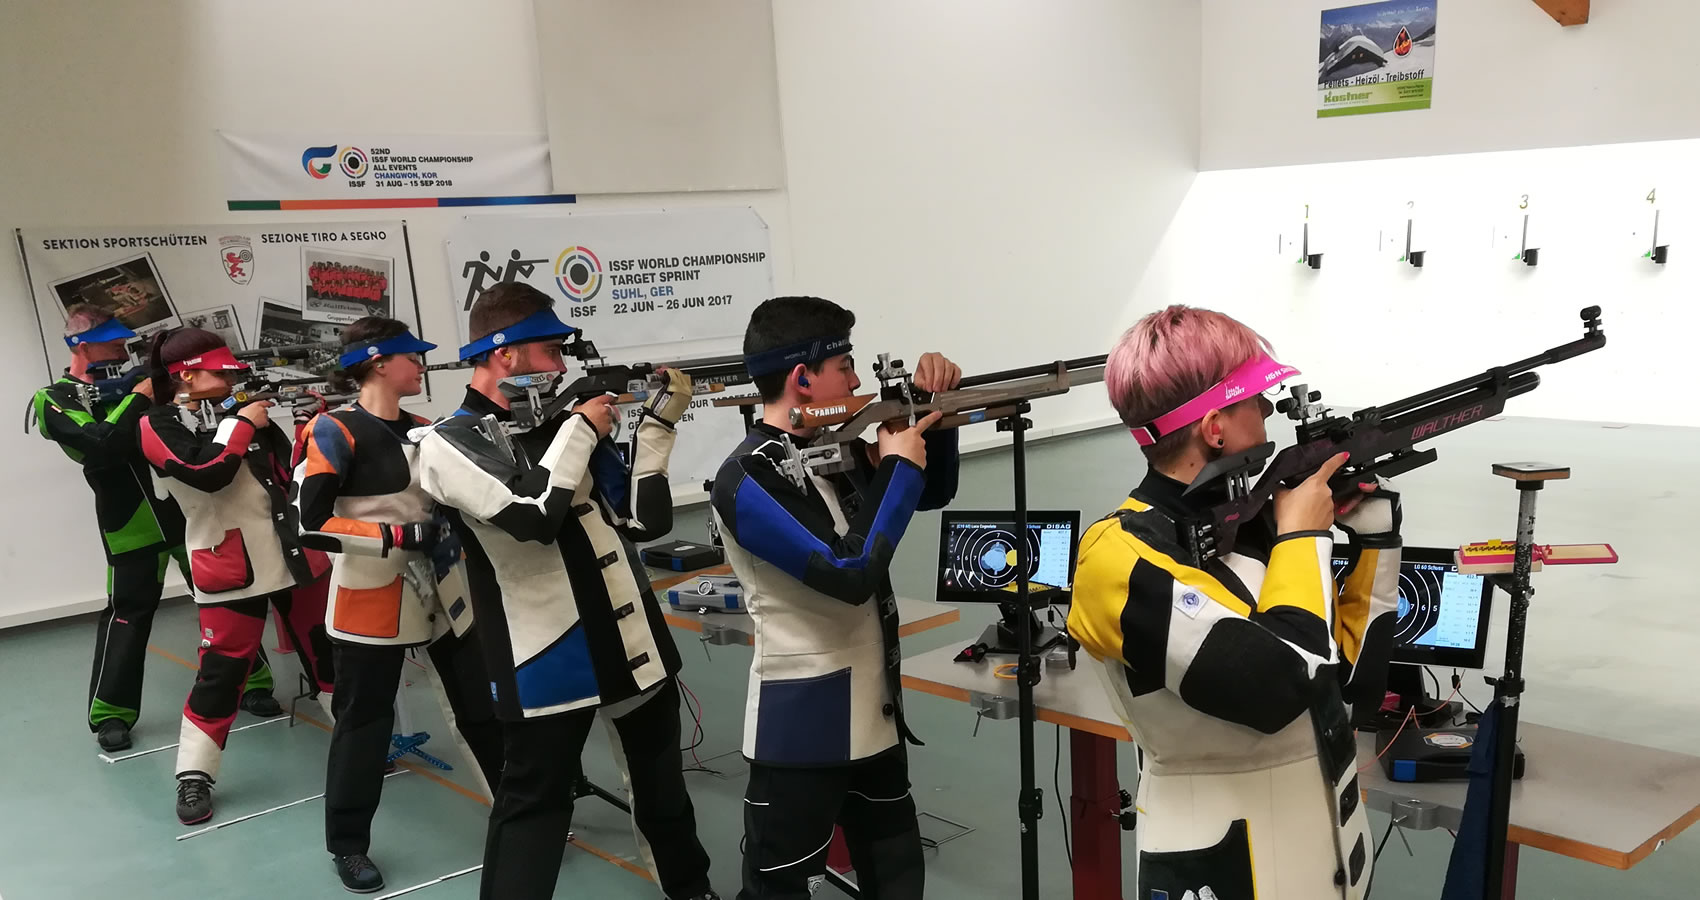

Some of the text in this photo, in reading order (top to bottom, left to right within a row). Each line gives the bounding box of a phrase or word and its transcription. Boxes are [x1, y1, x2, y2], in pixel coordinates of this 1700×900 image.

[1355, 74, 1380, 86] Heizöl
[1386, 69, 1425, 82] Treibstoff
[1324, 91, 1372, 103] Kostner
[374, 172, 421, 180] CHANGWON,
[1519, 194, 1529, 209] 3
[1646, 188, 1656, 204] 4
[1305, 204, 1309, 218] 1
[43, 239, 100, 250] SEKTION
[103, 234, 208, 248] SPORTSCHÜTZEN
[261, 233, 309, 243] SEZIONE
[311, 233, 338, 242] TIRO
[340, 233, 348, 241] A
[350, 231, 387, 241] SEGNO
[609, 252, 766, 271] ISSF WORLD CHAMPIONSHIP
[610, 270, 701, 285] TARGET SPRINT
[612, 286, 674, 300] SUHL, GER
[613, 303, 628, 314] 22
[630, 301, 654, 312] JUN
[666, 299, 680, 310] 26
[682, 297, 705, 309] JUN
[708, 295, 732, 306] 2017
[570, 306, 597, 318] ISSF
[695, 375, 738, 389] WALTHER
[814, 405, 847, 417] PARDINI
[1410, 404, 1483, 441] WALTHER
[1410, 603, 1438, 613] 7 6 5
